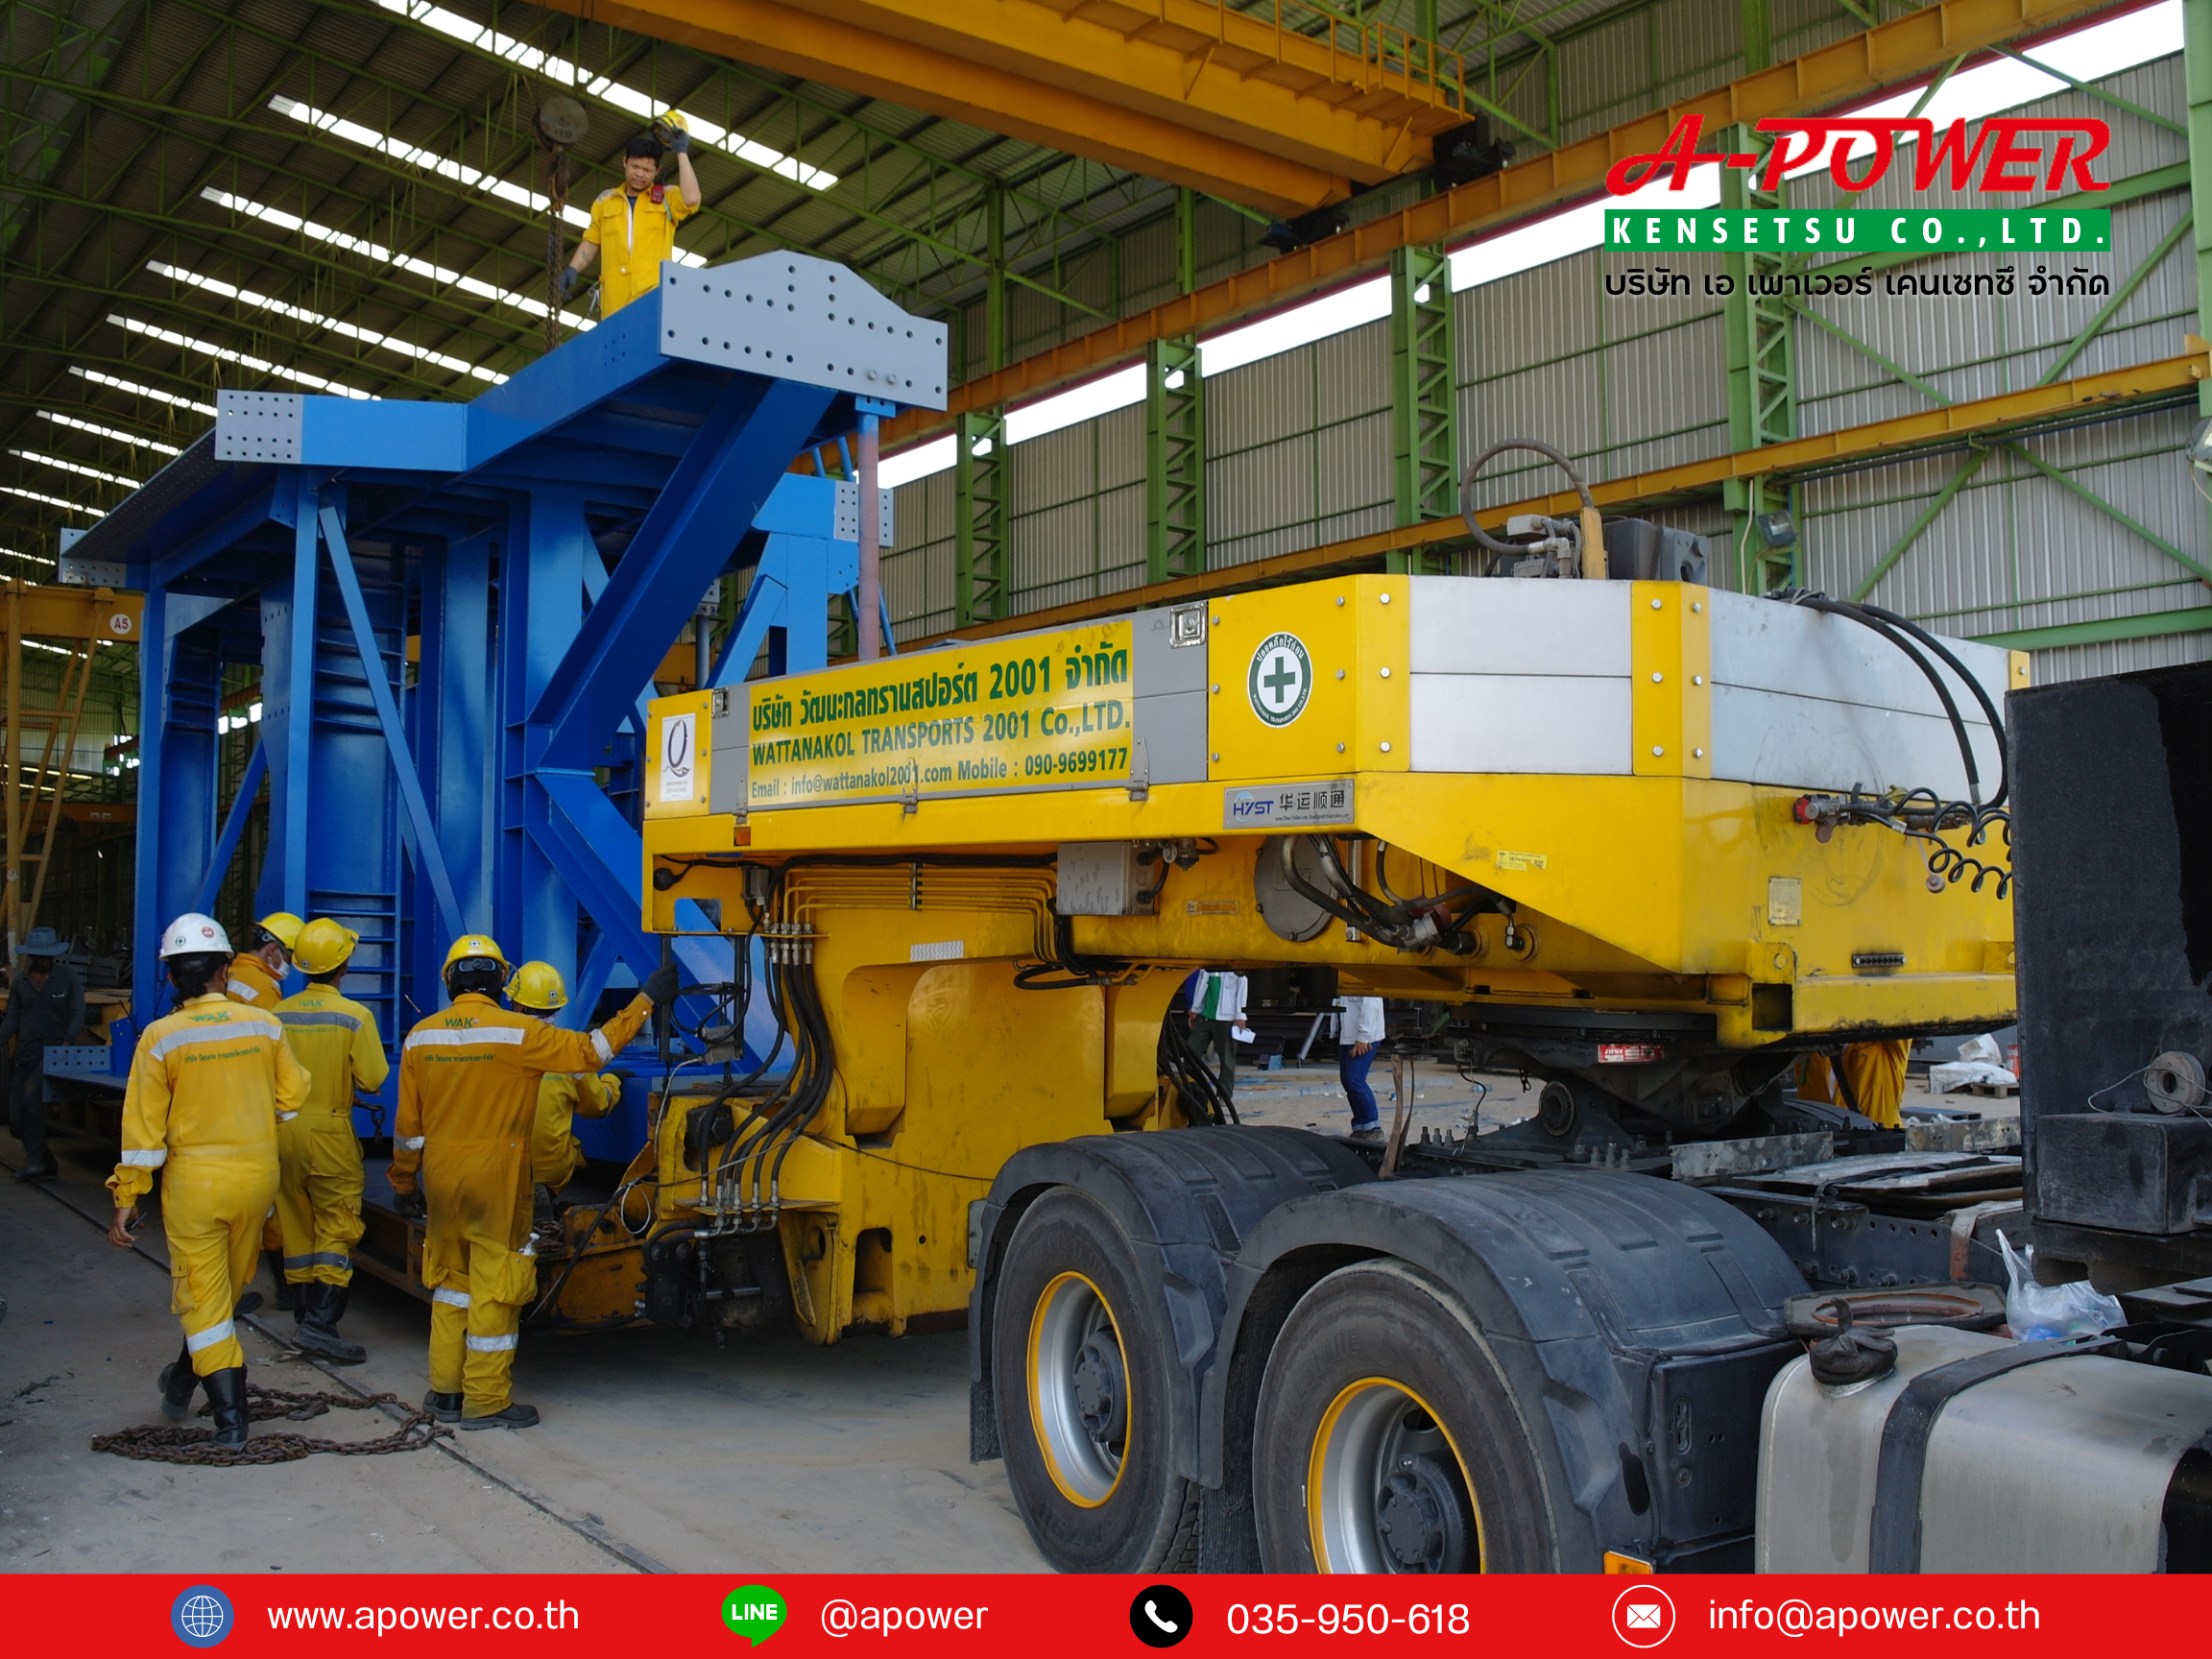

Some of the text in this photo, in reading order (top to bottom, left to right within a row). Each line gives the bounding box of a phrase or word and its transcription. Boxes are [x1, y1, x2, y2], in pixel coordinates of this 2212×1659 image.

[114, 617, 129, 630] A5
[753, 641, 1128, 732] บริษัท วัฒนะกลทรานสปอร์ต 2001 จำกัด
[753, 700, 1130, 766] WATTANAKOL TRANSPORTS 2001 Co.,LTD.
[752, 779, 780, 799] Email
[958, 757, 1007, 781] Mobile
[1025, 748, 1128, 776] 090-9699177
[1233, 801, 1274, 816] HYST
[1279, 789, 1345, 811] 华运顺通
[299, 999, 324, 1008] WAK
[445, 1018, 474, 1027] WAK
